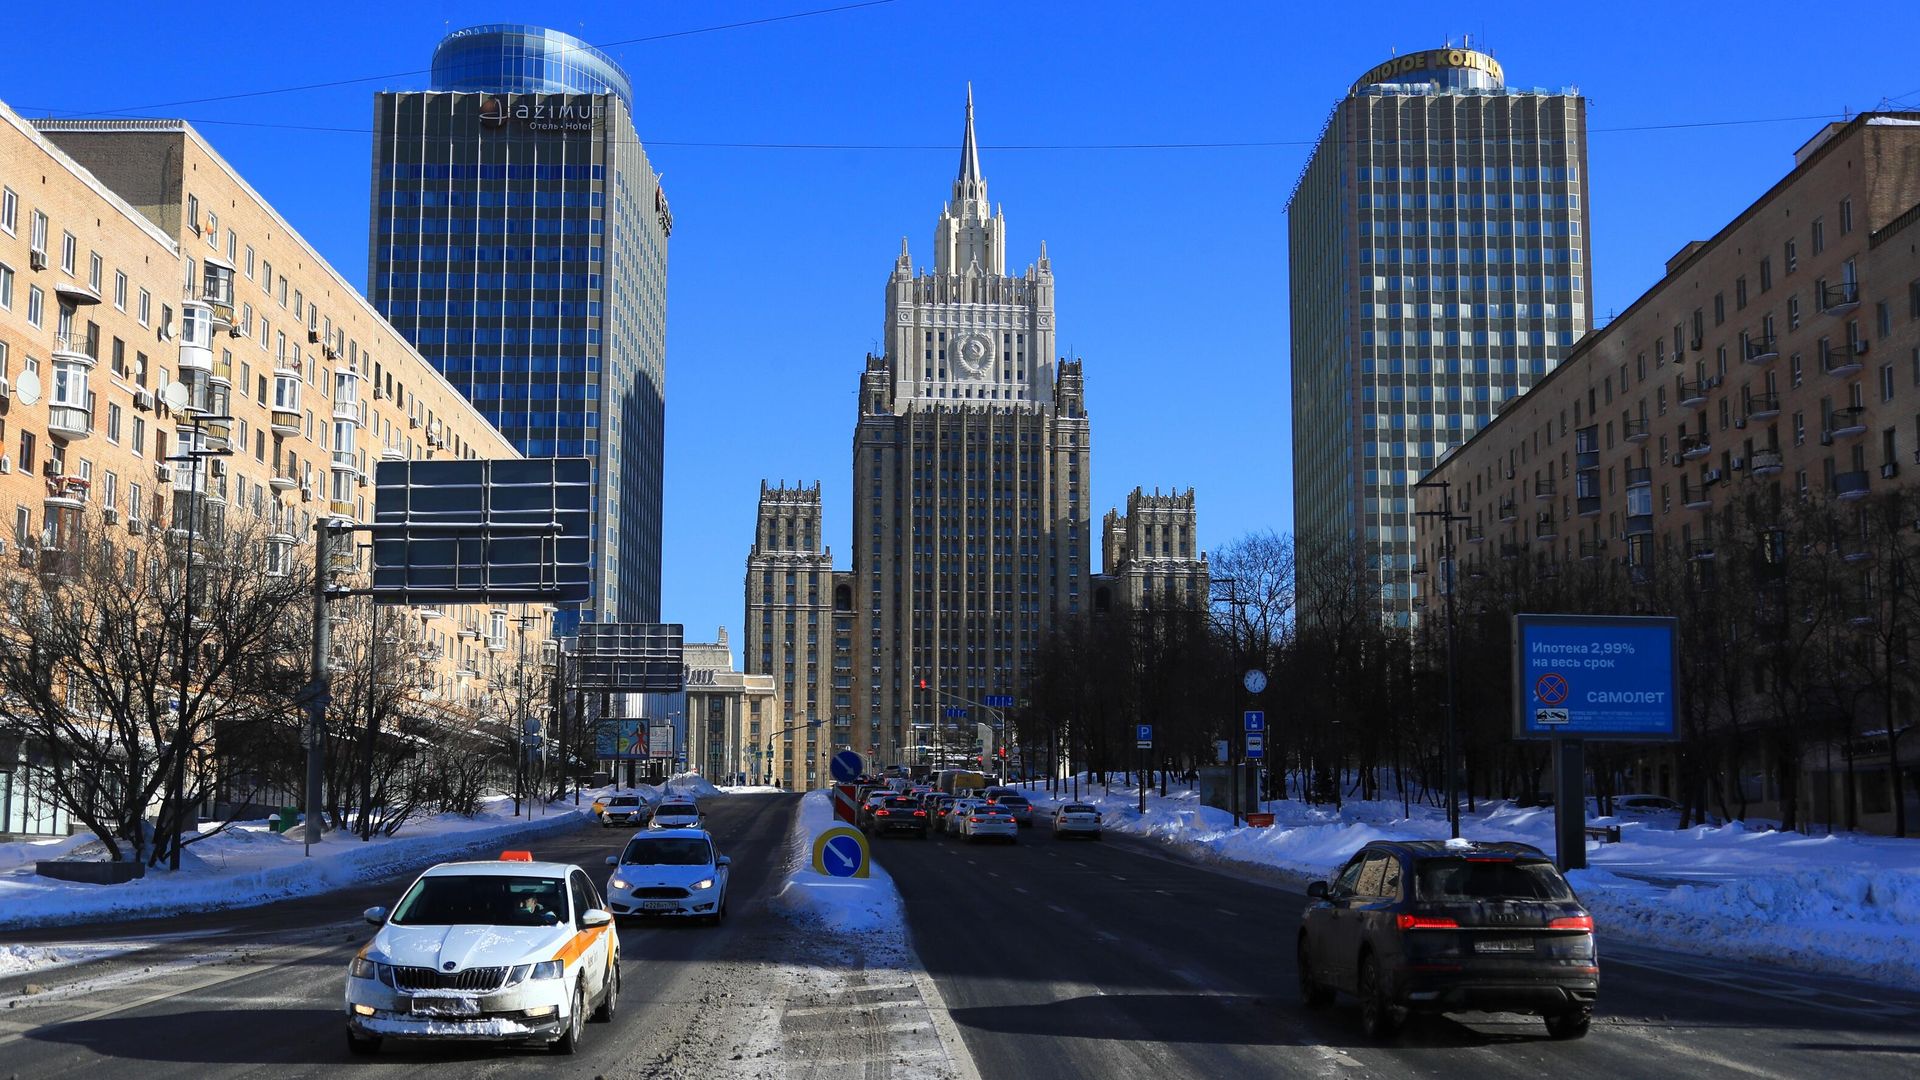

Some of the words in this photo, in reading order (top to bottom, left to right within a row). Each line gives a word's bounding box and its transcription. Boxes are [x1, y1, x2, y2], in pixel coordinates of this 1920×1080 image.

[1359, 53, 1425, 85] ОЛОТОЕ
[529, 122, 559, 130] Отель
[565, 122, 591, 130] Hotel
[1532, 642, 1588, 654] Ипотека
[1591, 642, 1635, 656] 2,99%
[1532, 659, 1548, 668] на
[1551, 659, 1581, 668] весь
[1584, 659, 1615, 670] срок
[1587, 691, 1665, 703] самолет
